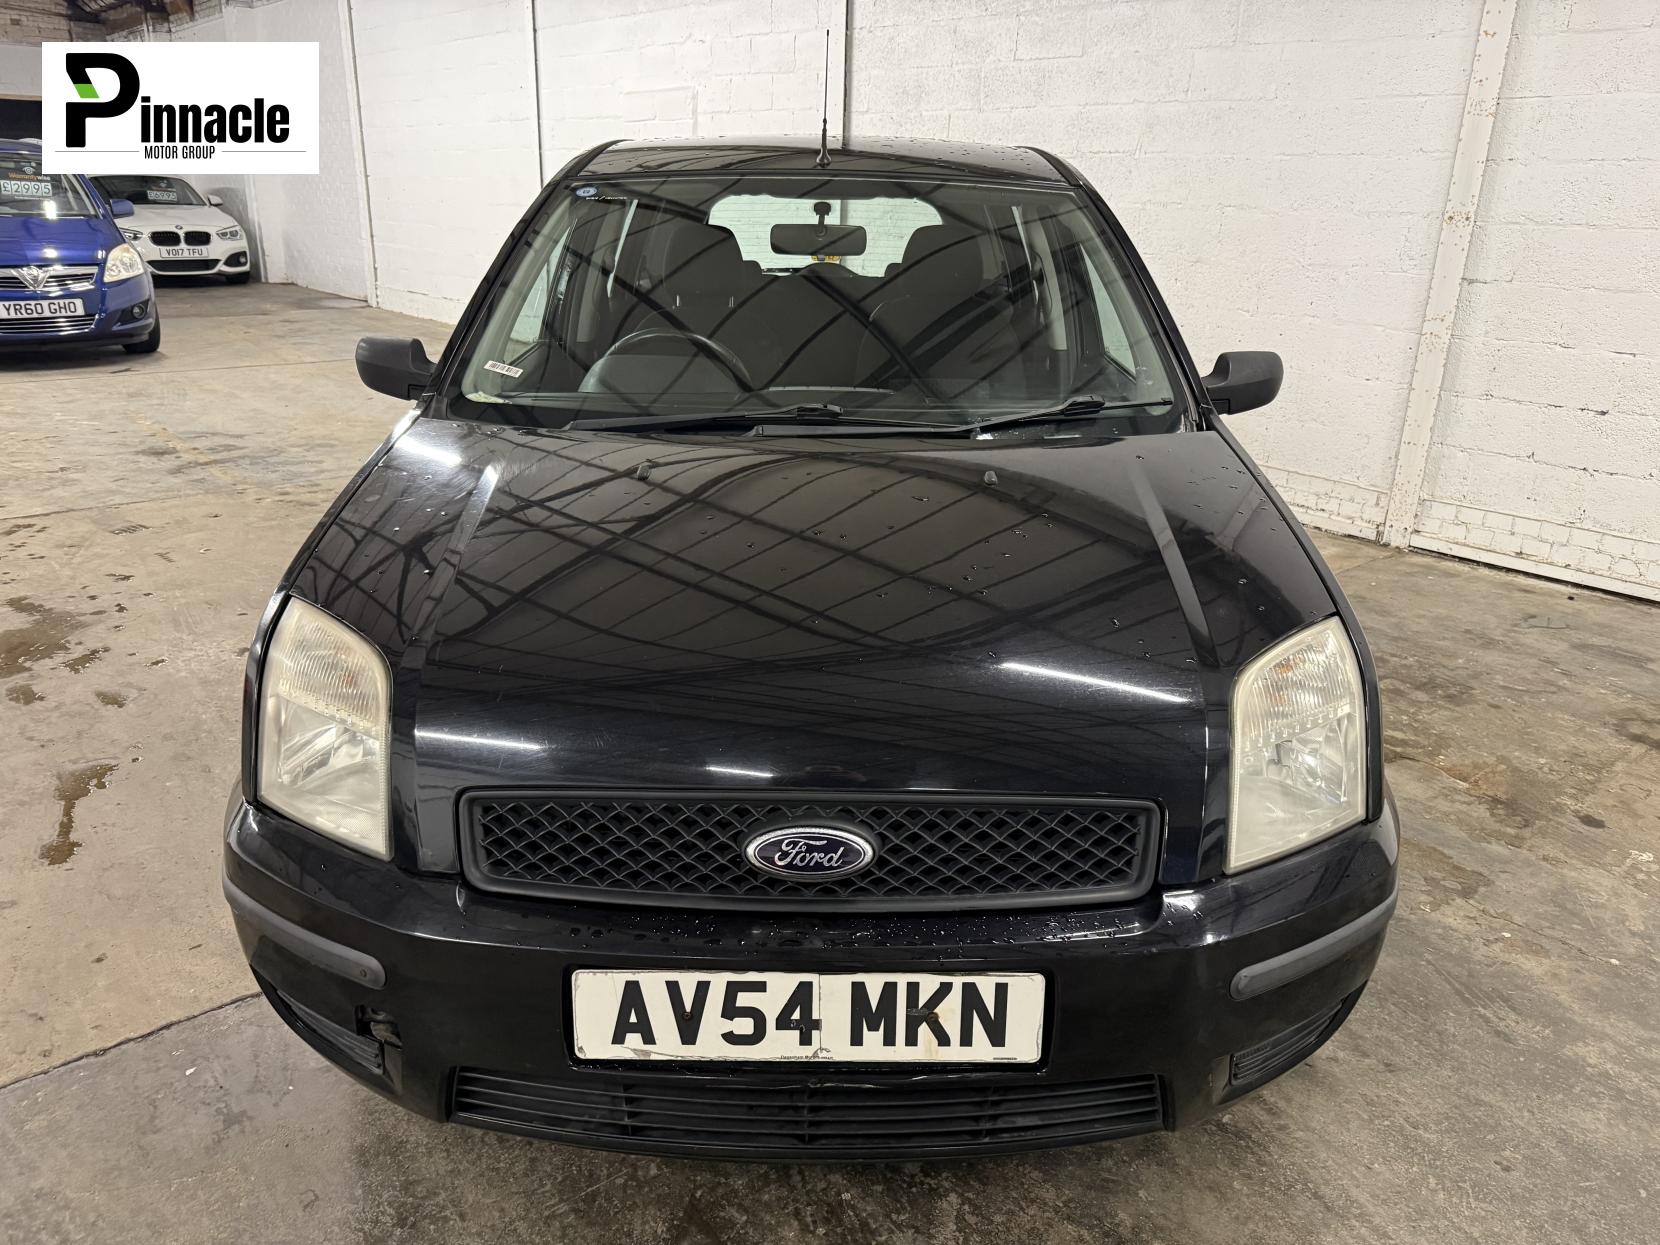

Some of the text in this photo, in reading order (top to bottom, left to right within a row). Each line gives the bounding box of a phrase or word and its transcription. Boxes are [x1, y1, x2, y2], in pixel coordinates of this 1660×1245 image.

[3, 181, 51, 195] £2995
[186, 248, 203, 256] TFU
[2, 301, 77, 316] YR60 GHO
[774, 838, 843, 867] Ford
[611, 980, 1009, 1047] AV54 MKN
